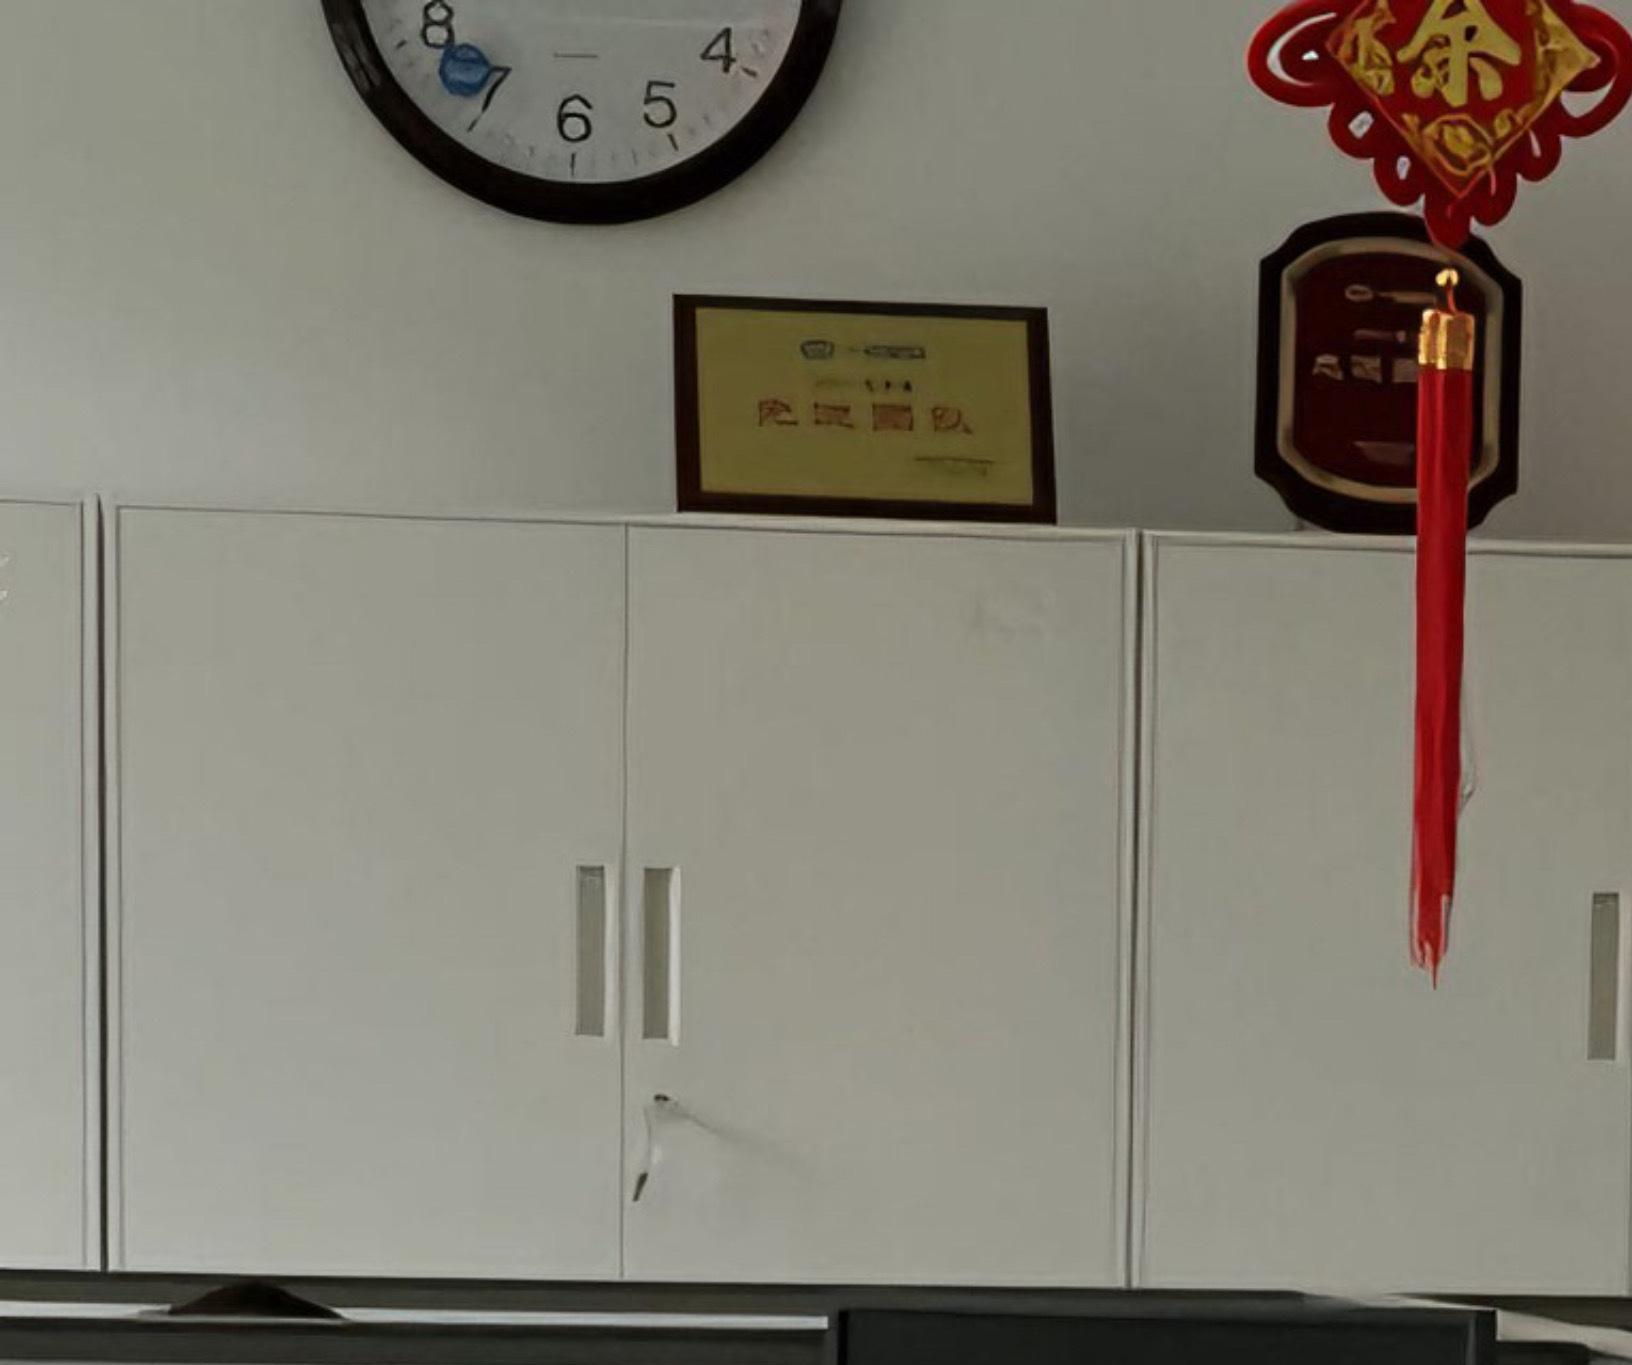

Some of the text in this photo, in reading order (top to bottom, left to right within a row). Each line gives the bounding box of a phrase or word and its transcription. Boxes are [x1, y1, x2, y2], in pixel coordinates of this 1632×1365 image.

[421, 0, 455, 49] 8
[701, 27, 737, 74] 4
[556, 94, 592, 142] 6
[643, 80, 677, 128] 5
